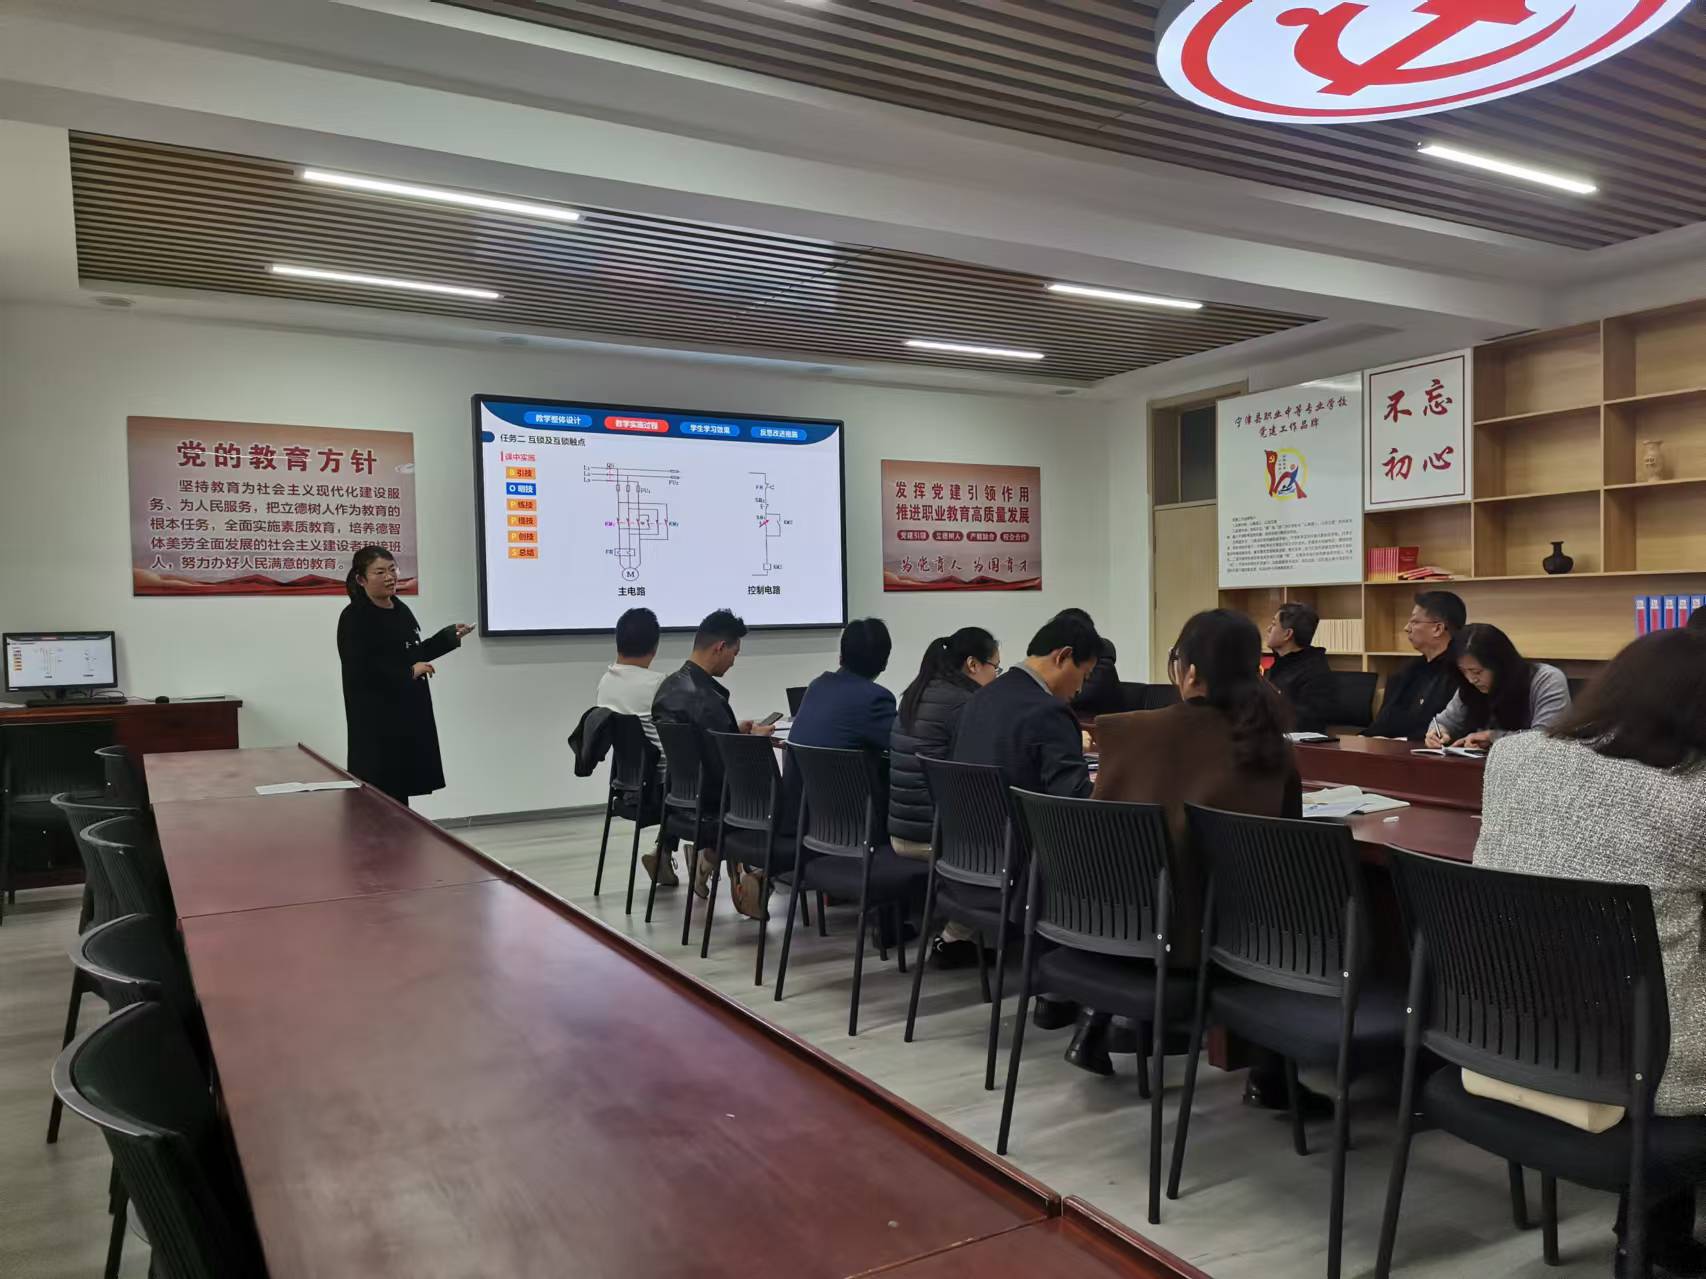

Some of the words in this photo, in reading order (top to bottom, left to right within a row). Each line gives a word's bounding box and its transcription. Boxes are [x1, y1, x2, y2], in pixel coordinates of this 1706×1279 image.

[1383, 378, 1453, 423] 不忘
[1259, 417, 1320, 438] 党建工作品牌
[500, 434, 526, 443] 任务二
[528, 434, 586, 447] 互锁及互锁触点
[177, 440, 377, 475] 党的教育方针
[1381, 445, 1455, 481] 初心
[179, 480, 401, 499] 坚持教育为社会主义现代化建设服
[895, 481, 1030, 503] 发挥党建引领作用
[896, 504, 1030, 524] 推进职业教育高质量发展
[618, 586, 646, 596] 主电路
[748, 585, 781, 596] 控制电路
